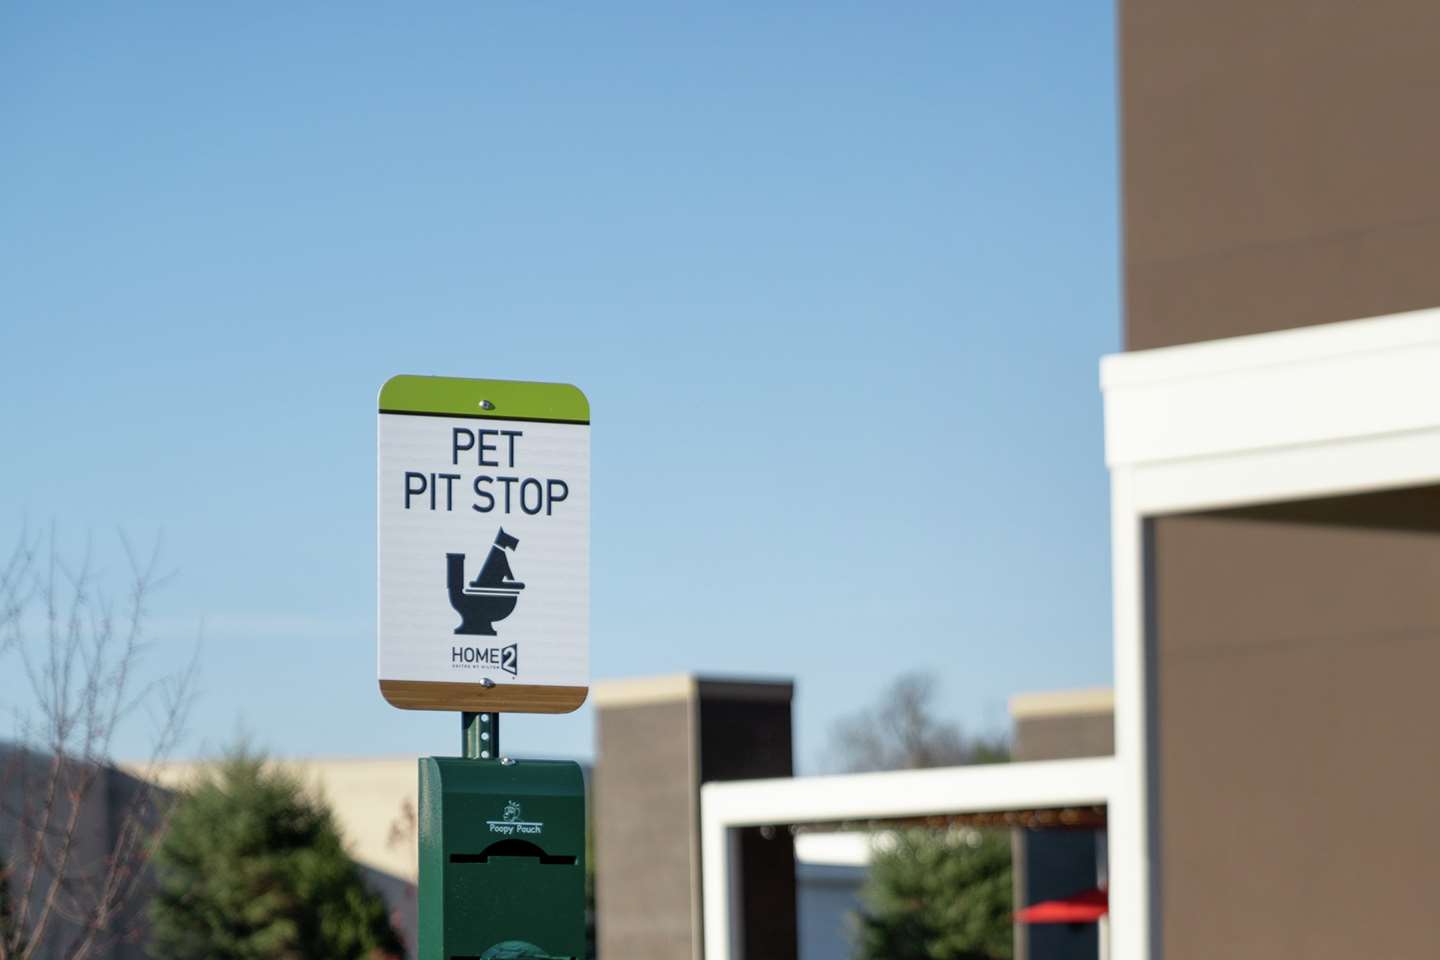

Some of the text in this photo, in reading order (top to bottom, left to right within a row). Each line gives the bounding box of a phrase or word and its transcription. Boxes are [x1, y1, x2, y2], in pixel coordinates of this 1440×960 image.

[452, 427, 523, 468] PET
[404, 471, 569, 516] PIT STOP
[489, 823, 542, 835] Poopy Pouch
